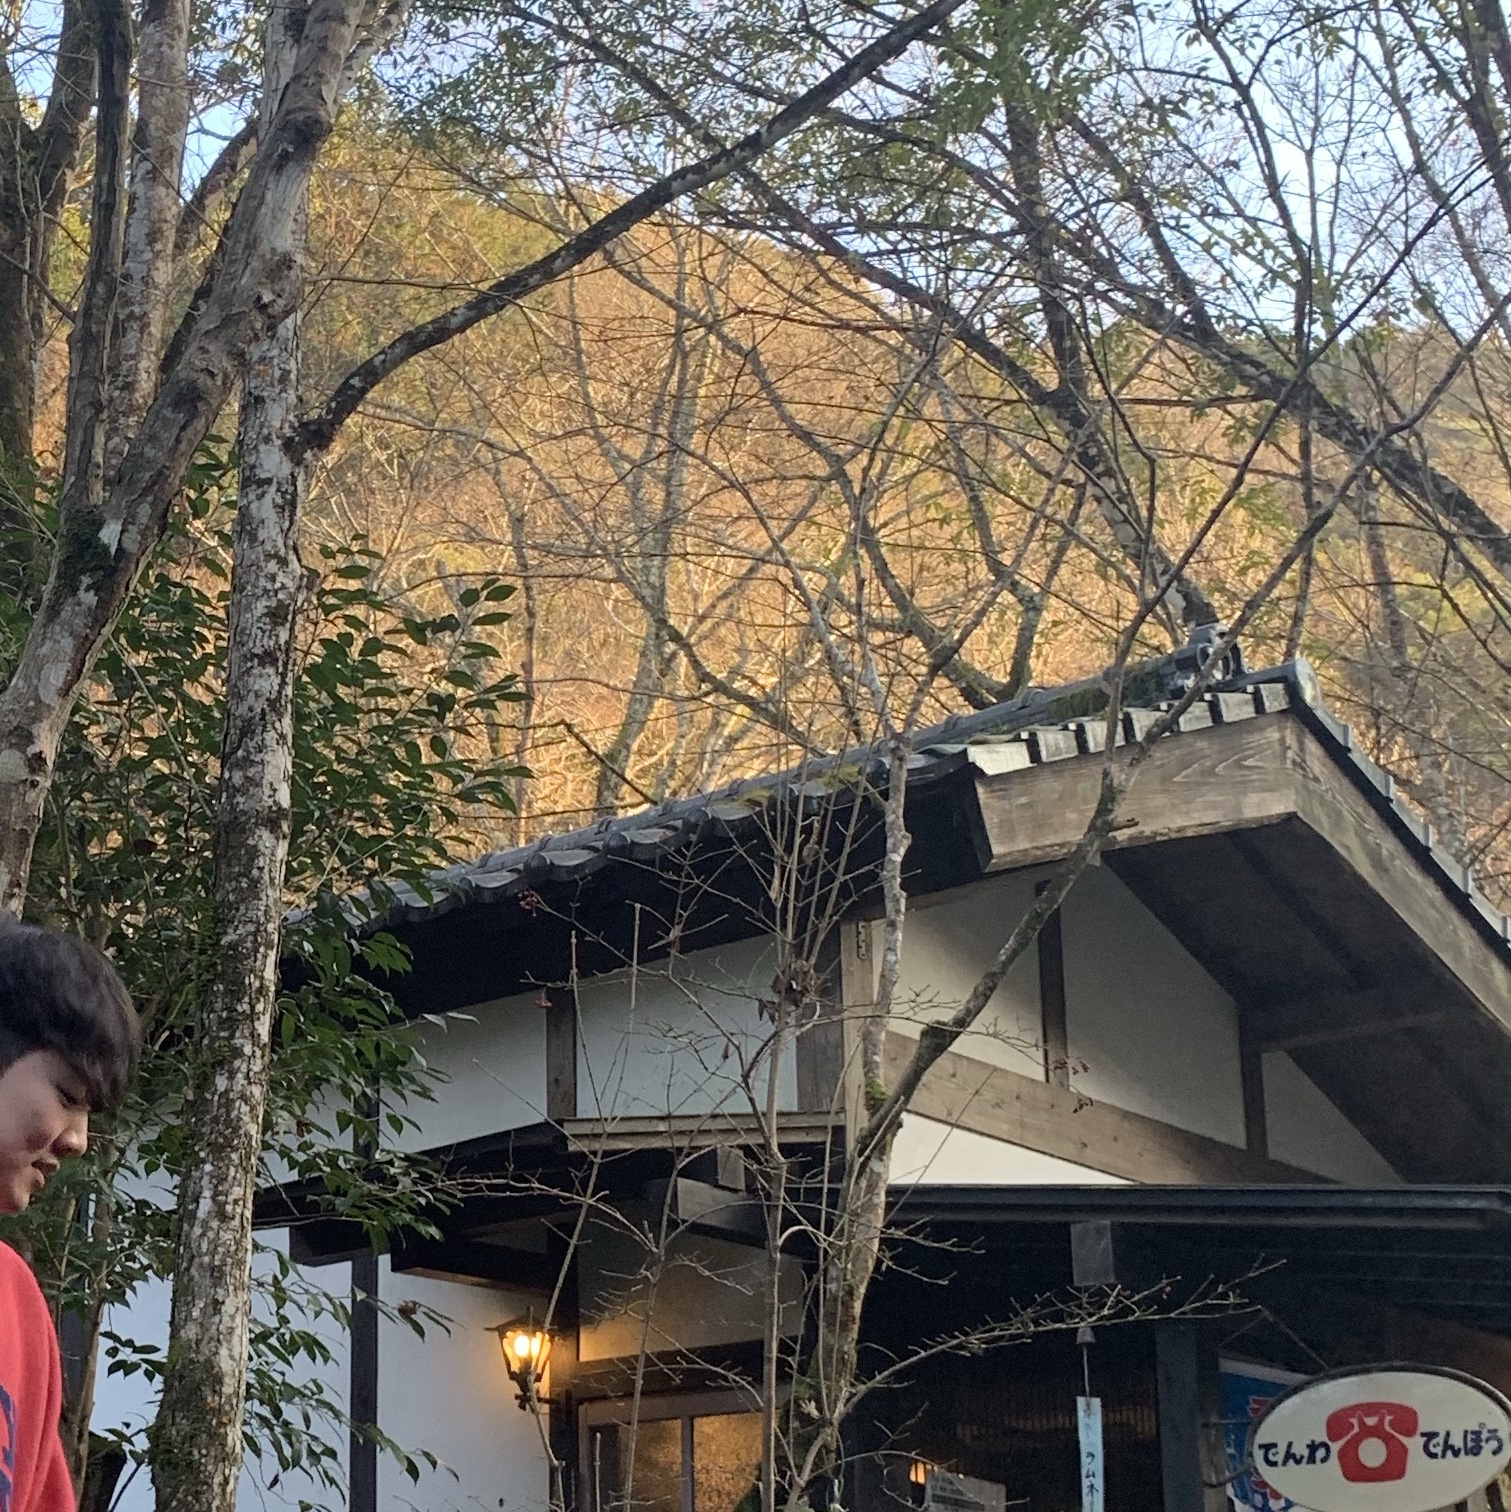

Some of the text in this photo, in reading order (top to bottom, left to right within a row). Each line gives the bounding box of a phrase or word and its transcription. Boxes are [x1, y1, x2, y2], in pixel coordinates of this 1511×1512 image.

[1258, 1439, 1332, 1468] でんわ
[1420, 1422, 1504, 1460] でんぽう
